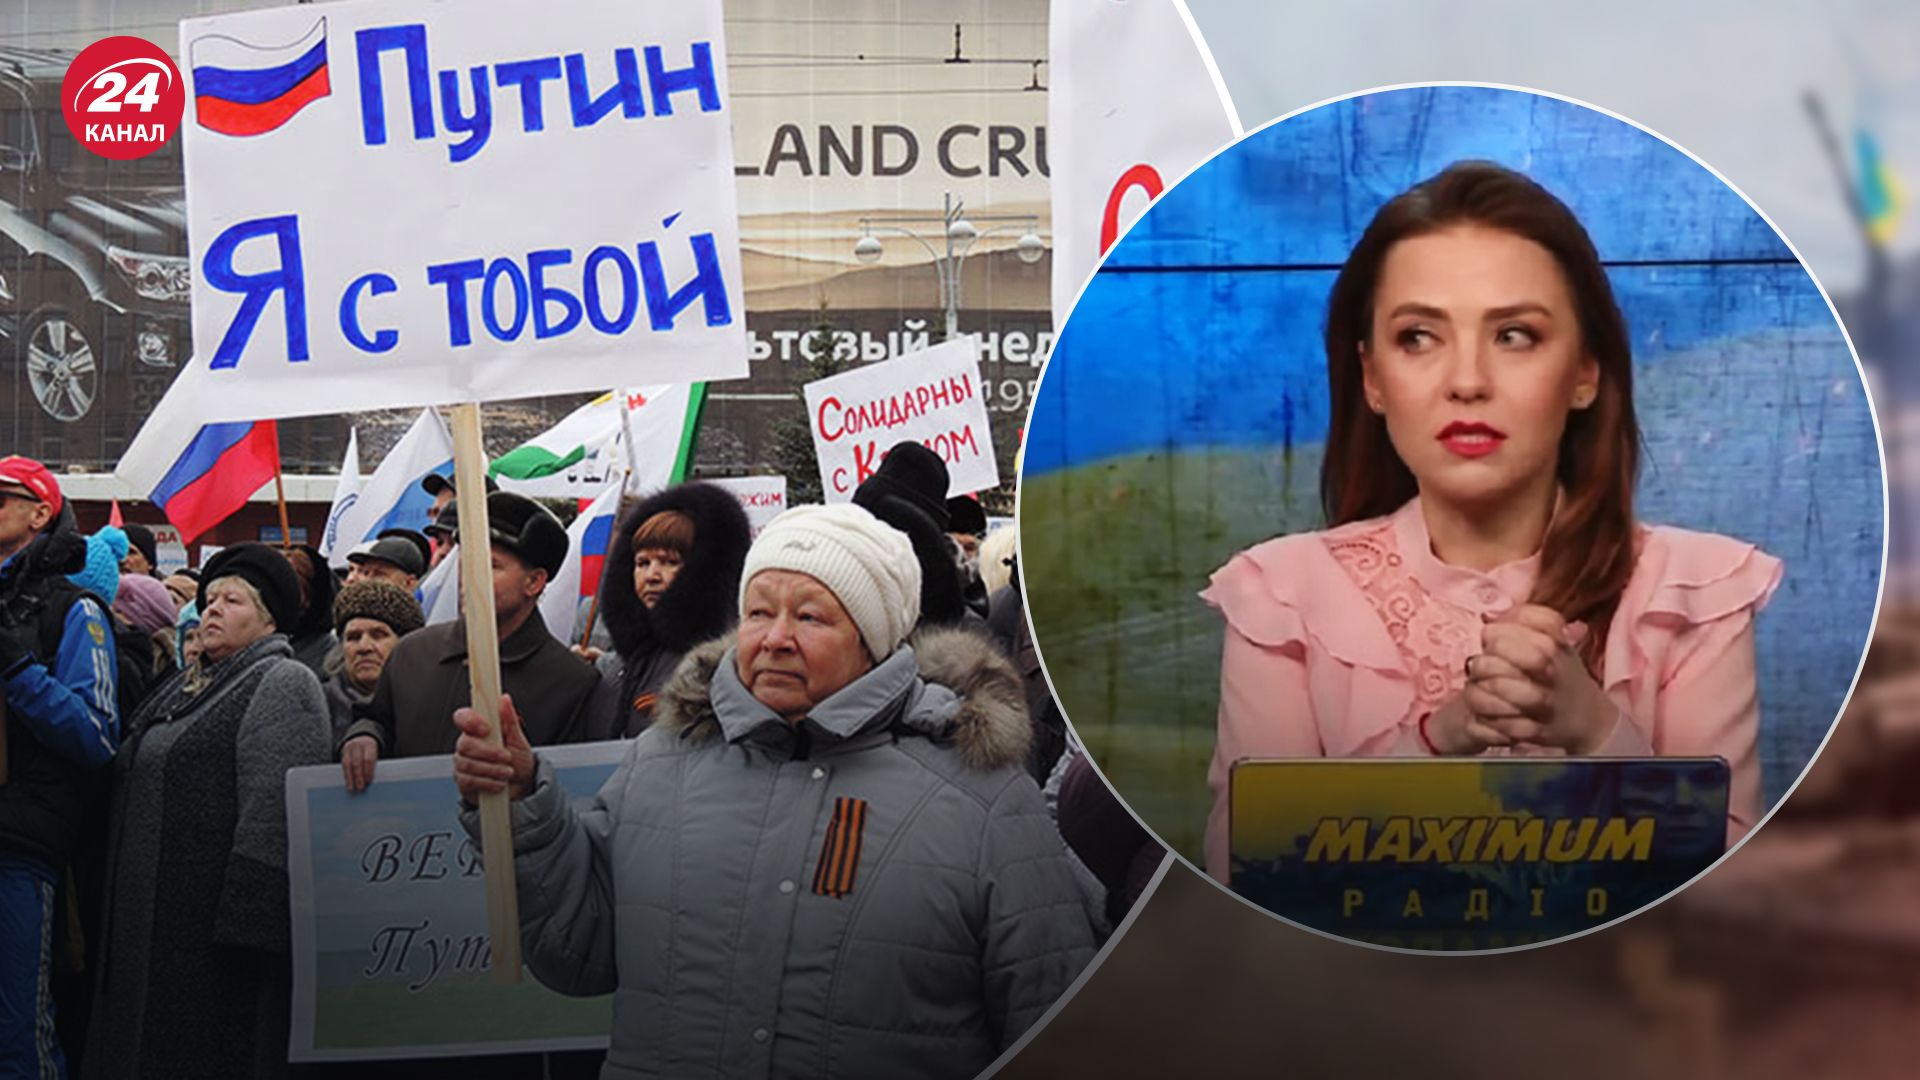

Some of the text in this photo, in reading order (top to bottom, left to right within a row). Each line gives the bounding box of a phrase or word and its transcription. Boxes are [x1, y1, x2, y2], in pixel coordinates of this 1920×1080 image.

[355, 24, 721, 162] Путин
[202, 214, 309, 370] Я
[960, 331, 1053, 367] нед
[1305, 817, 1654, 863] MAXIMUM
